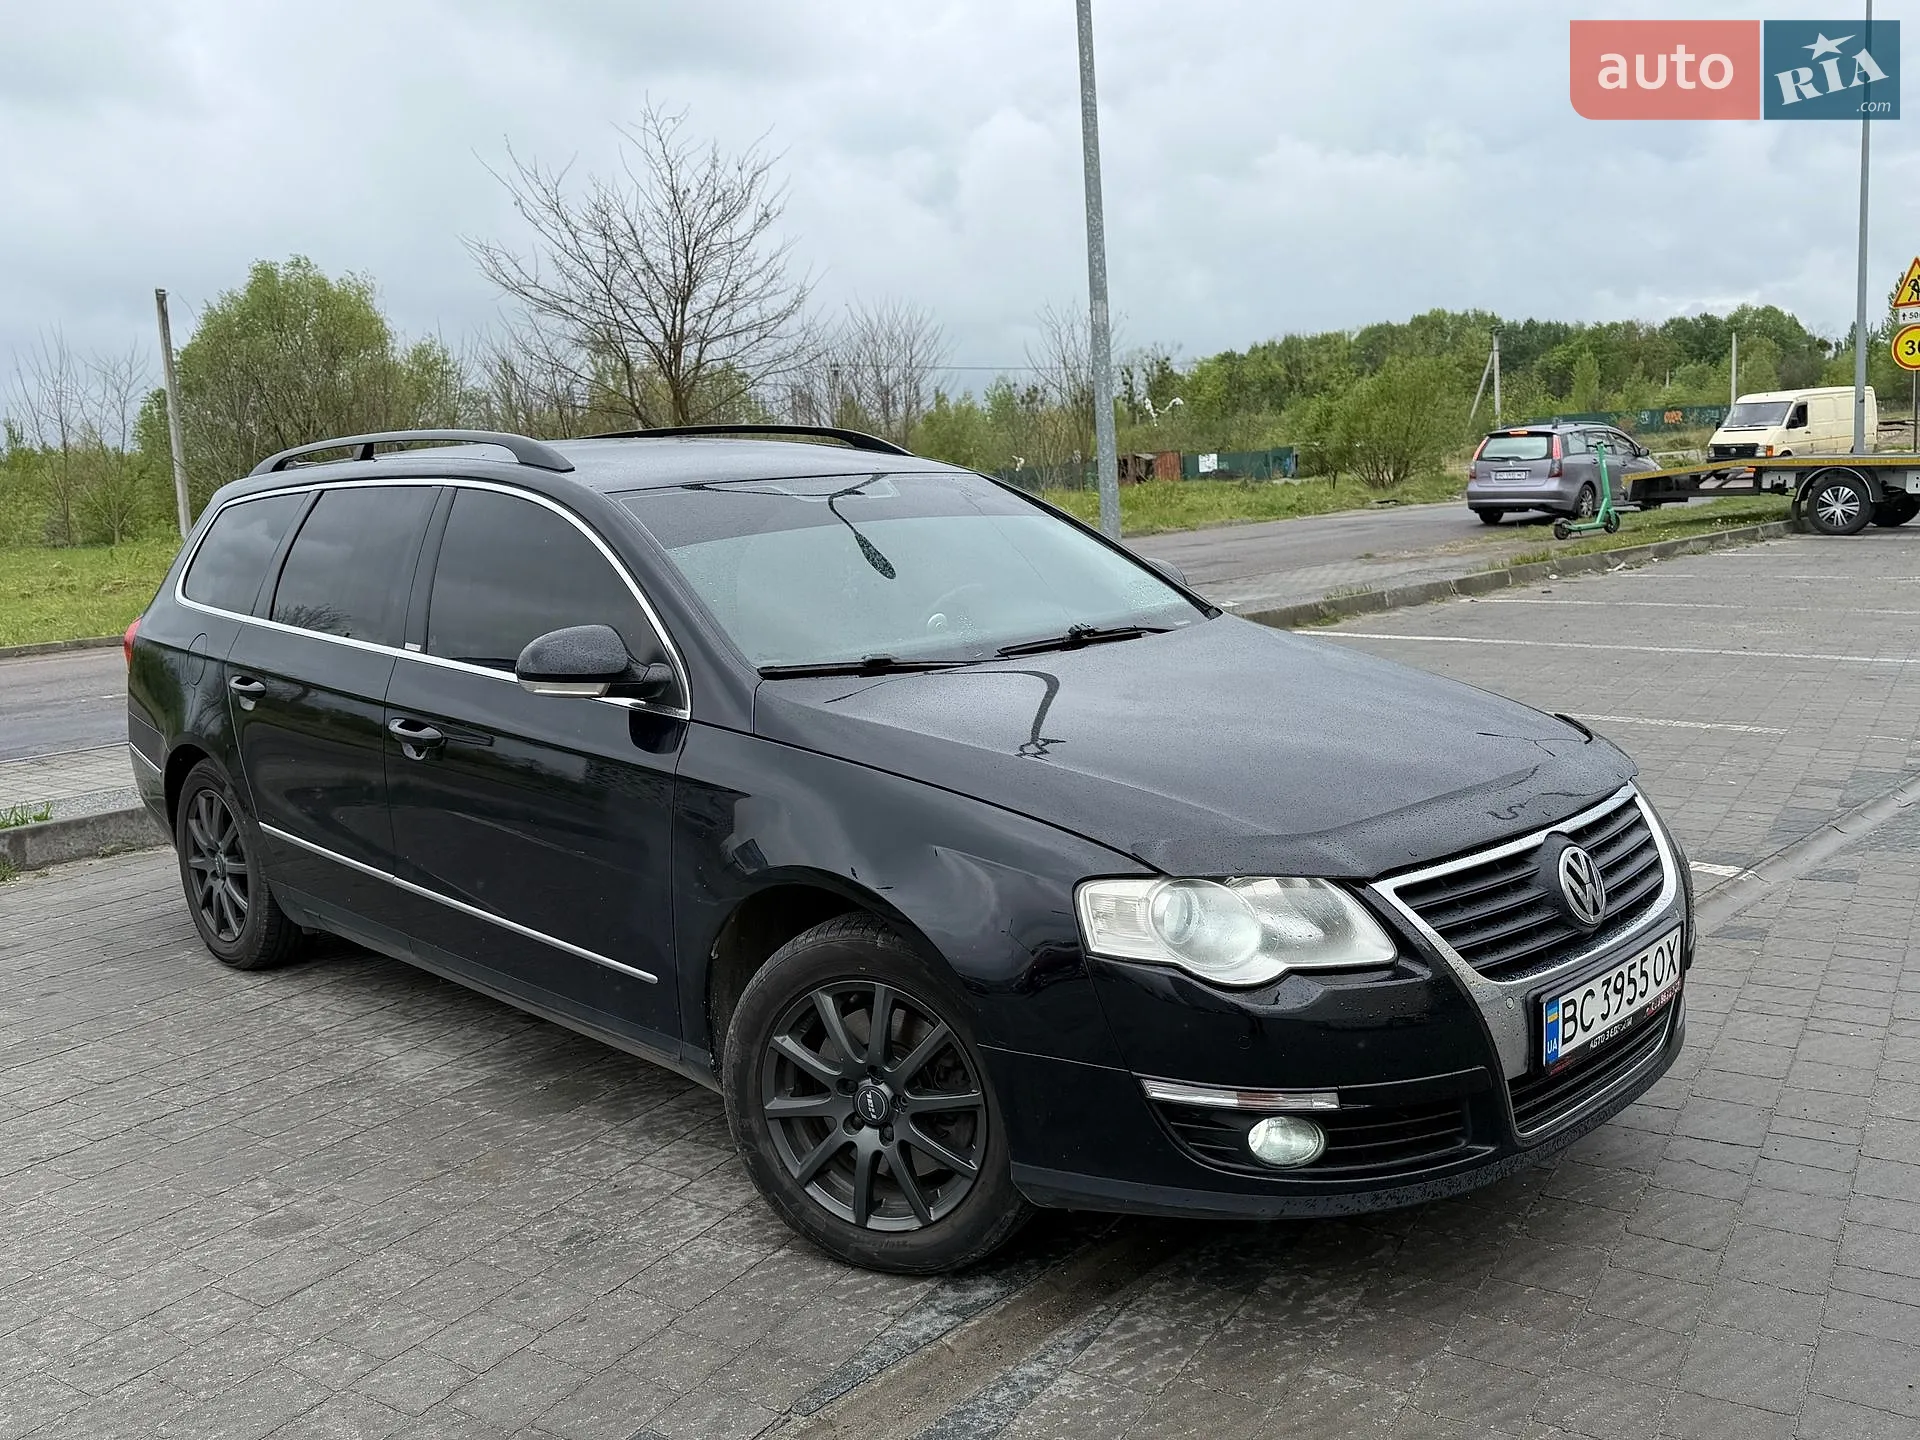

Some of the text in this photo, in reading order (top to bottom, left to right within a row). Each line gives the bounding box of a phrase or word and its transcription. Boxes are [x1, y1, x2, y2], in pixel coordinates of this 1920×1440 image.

[1909, 311, 1920, 320] 50
[1905, 340, 1920, 356] 3
[1561, 988, 1596, 1046] BC
[1600, 954, 1649, 1021] 3955
[1653, 935, 1678, 987] OX
[1547, 1038, 1558, 1054] UA
